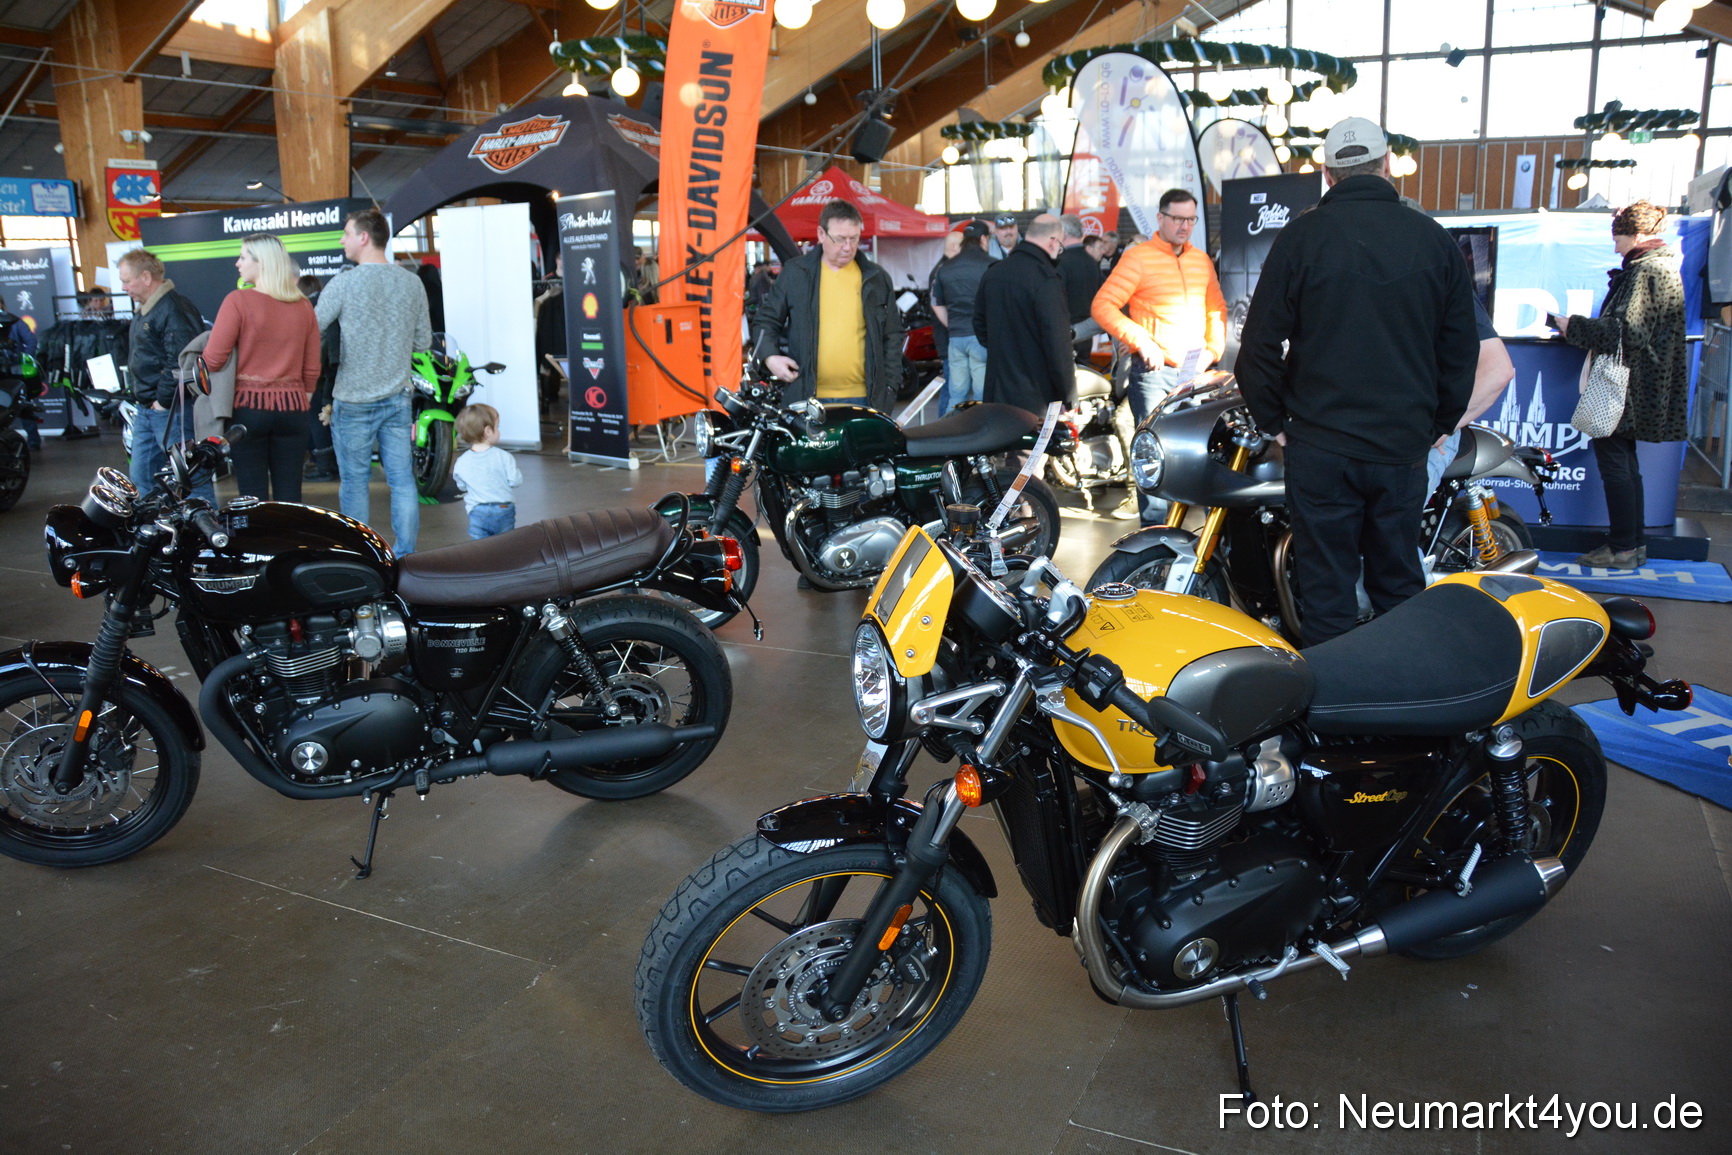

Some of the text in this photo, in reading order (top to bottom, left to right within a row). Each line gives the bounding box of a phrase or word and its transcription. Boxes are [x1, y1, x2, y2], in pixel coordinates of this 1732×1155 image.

[480, 128, 559, 151] HARLEY-DAVIDSON
[223, 206, 340, 233] Kawasaki Herold
[328, 254, 344, 264] Lauf
[200, 579, 251, 590] TRIUMPH
[427, 637, 486, 648] BONNEVILLE
